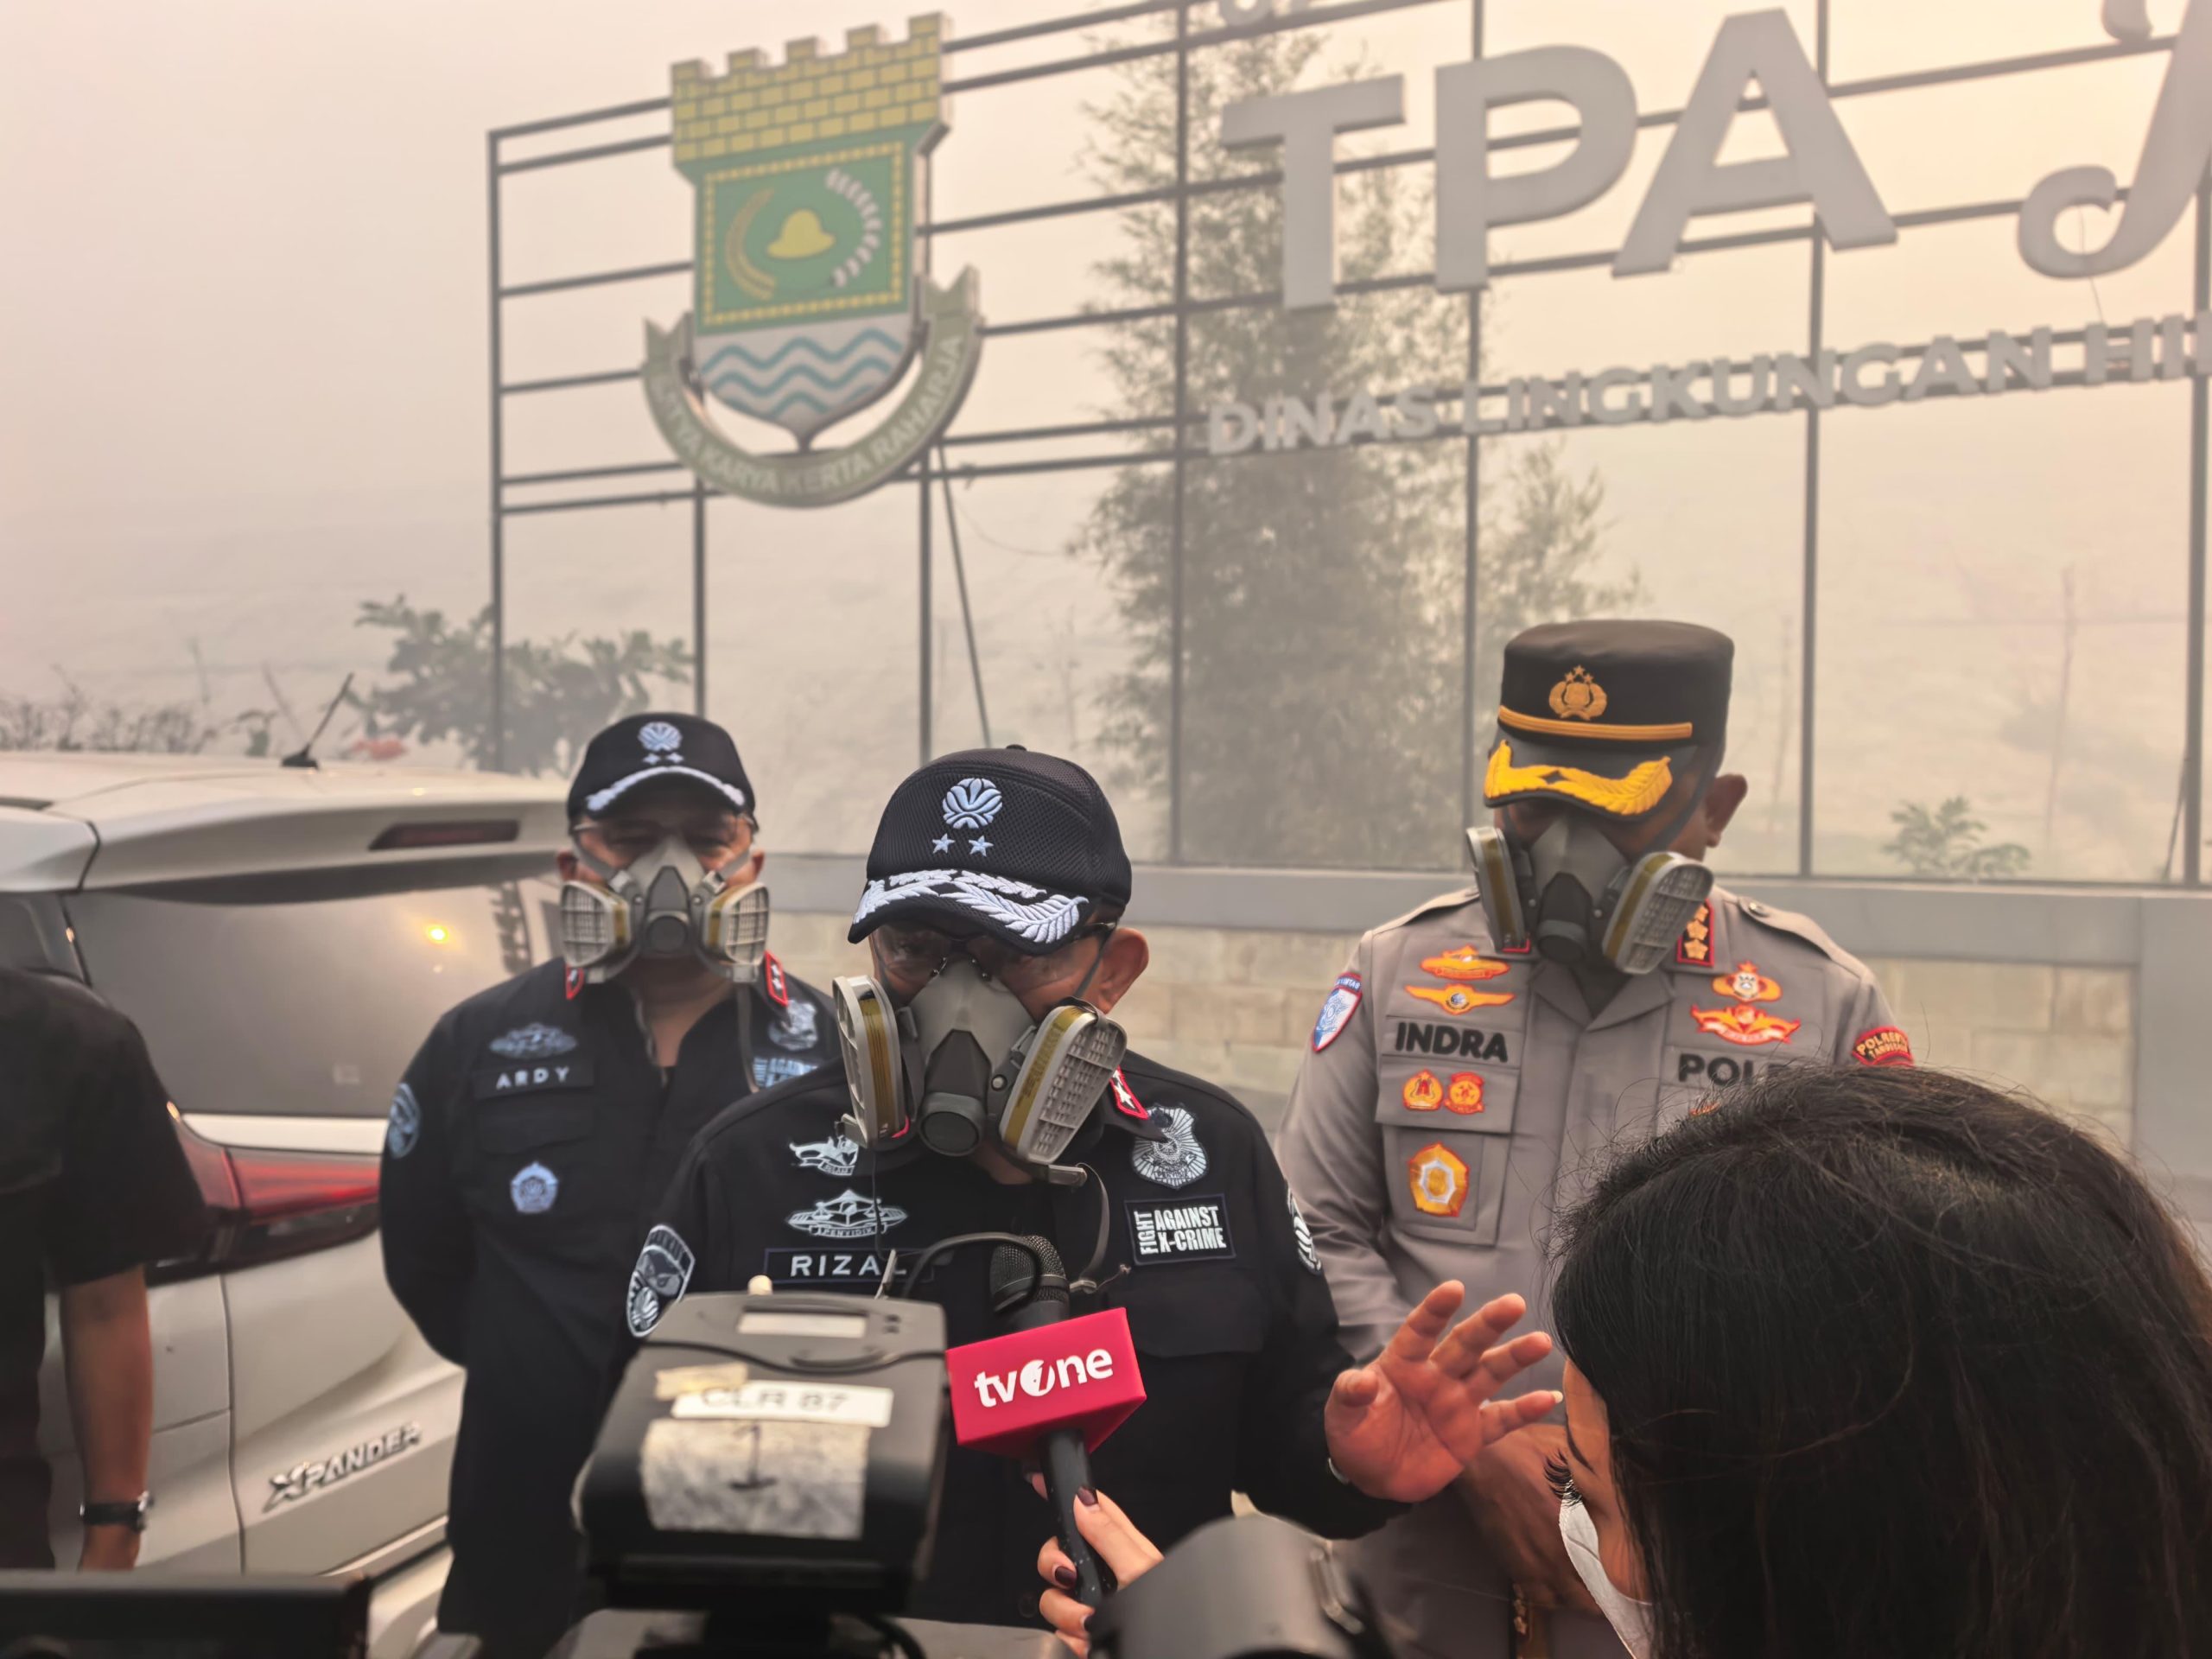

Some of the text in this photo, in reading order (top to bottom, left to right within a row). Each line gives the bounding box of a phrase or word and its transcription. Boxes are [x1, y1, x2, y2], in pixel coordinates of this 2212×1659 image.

[1219, 8, 1897, 310] TPA
[869, 335, 963, 463] RAHARJA
[1210, 385, 1438, 456] DINAS
[1464, 326, 2053, 435] LINGKUNGAN
[1395, 1021, 1509, 1063] INDRA
[496, 1066, 570, 1090] ARDY
[1678, 1053, 1790, 1087] POL
[1134, 1205, 1219, 1255] FIGHT AGAINST
[1157, 1227, 1227, 1254] X-CRIME
[262, 1421, 423, 1514] XPANDER
